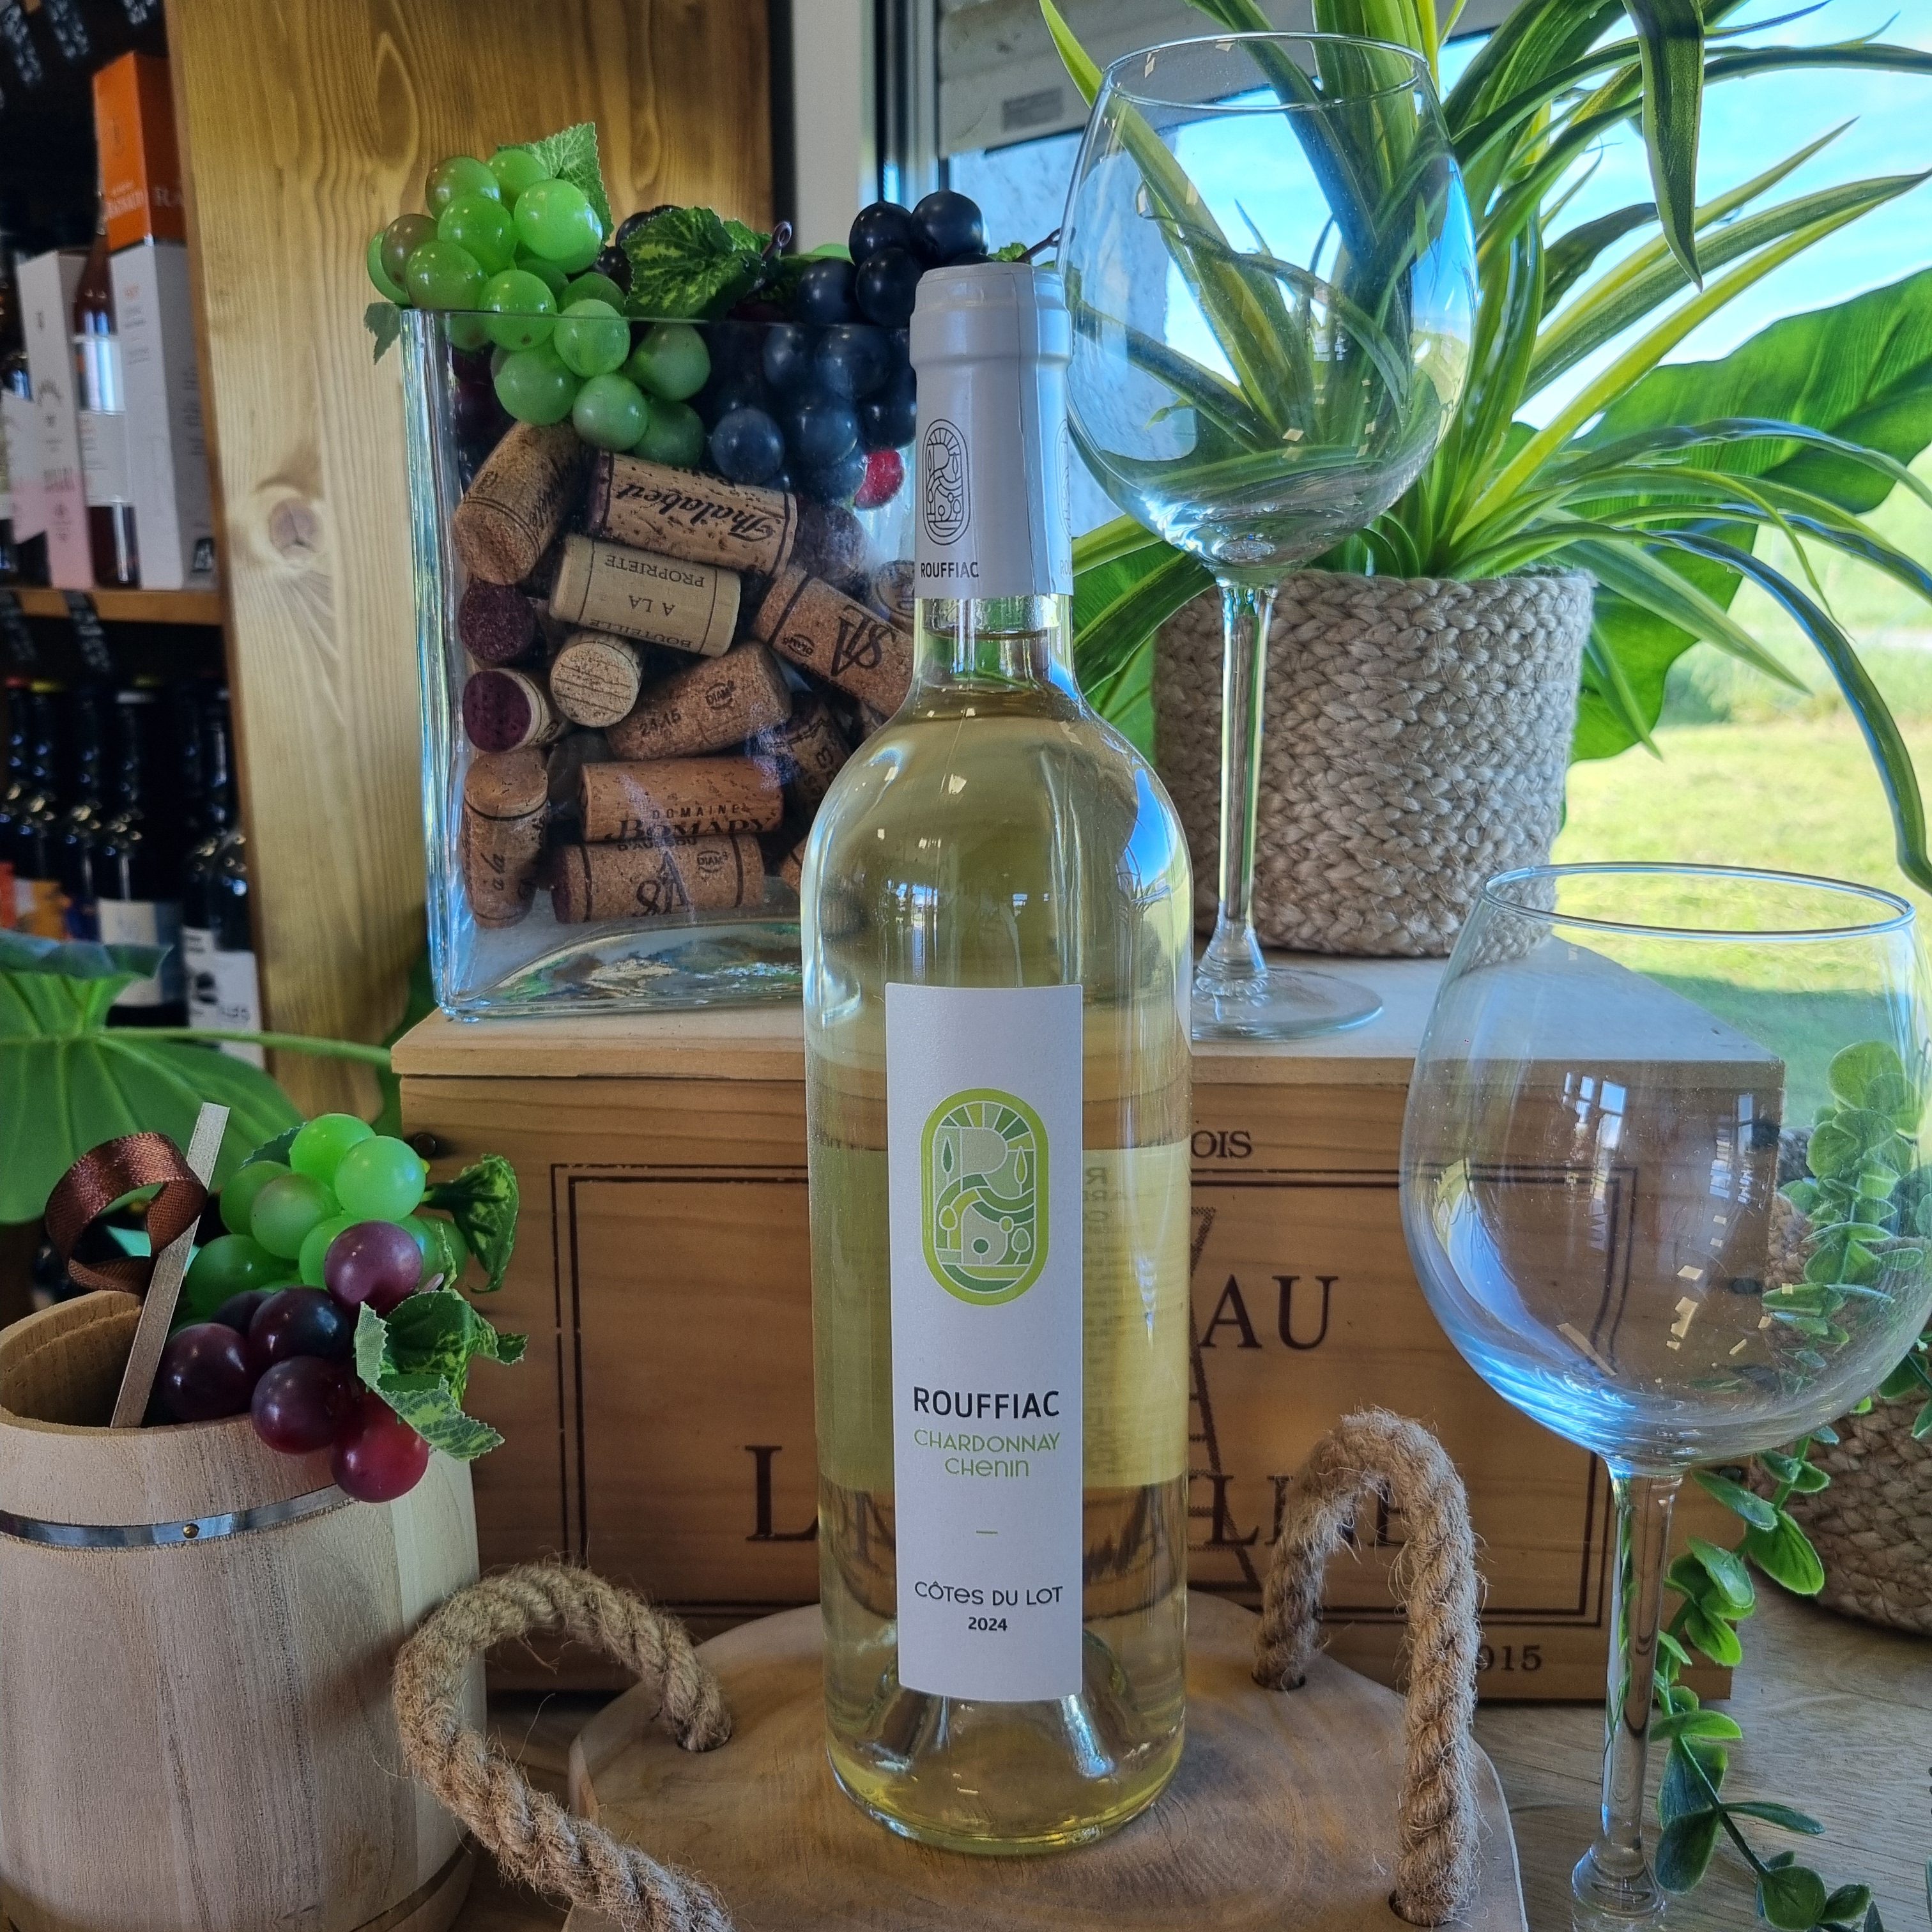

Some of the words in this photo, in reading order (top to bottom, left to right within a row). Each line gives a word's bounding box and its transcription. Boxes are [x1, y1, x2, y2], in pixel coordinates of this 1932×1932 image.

[604, 554, 705, 588] PROPRIETE
[920, 561, 979, 579] ROUFFIAC
[629, 595, 653, 613] LA
[661, 602, 677, 617] A
[588, 618, 694, 649] BOUTEILLE
[652, 803, 739, 820] DOMAINE
[913, 1386, 1061, 1419] ROUFFIAC
[914, 1429, 1061, 1453] CHARDONNAY
[992, 1589, 1018, 1606] DU
[1025, 1585, 1064, 1606] LOT
[967, 1616, 1008, 1632] 2024
[1476, 1644, 1542, 1672] 015
